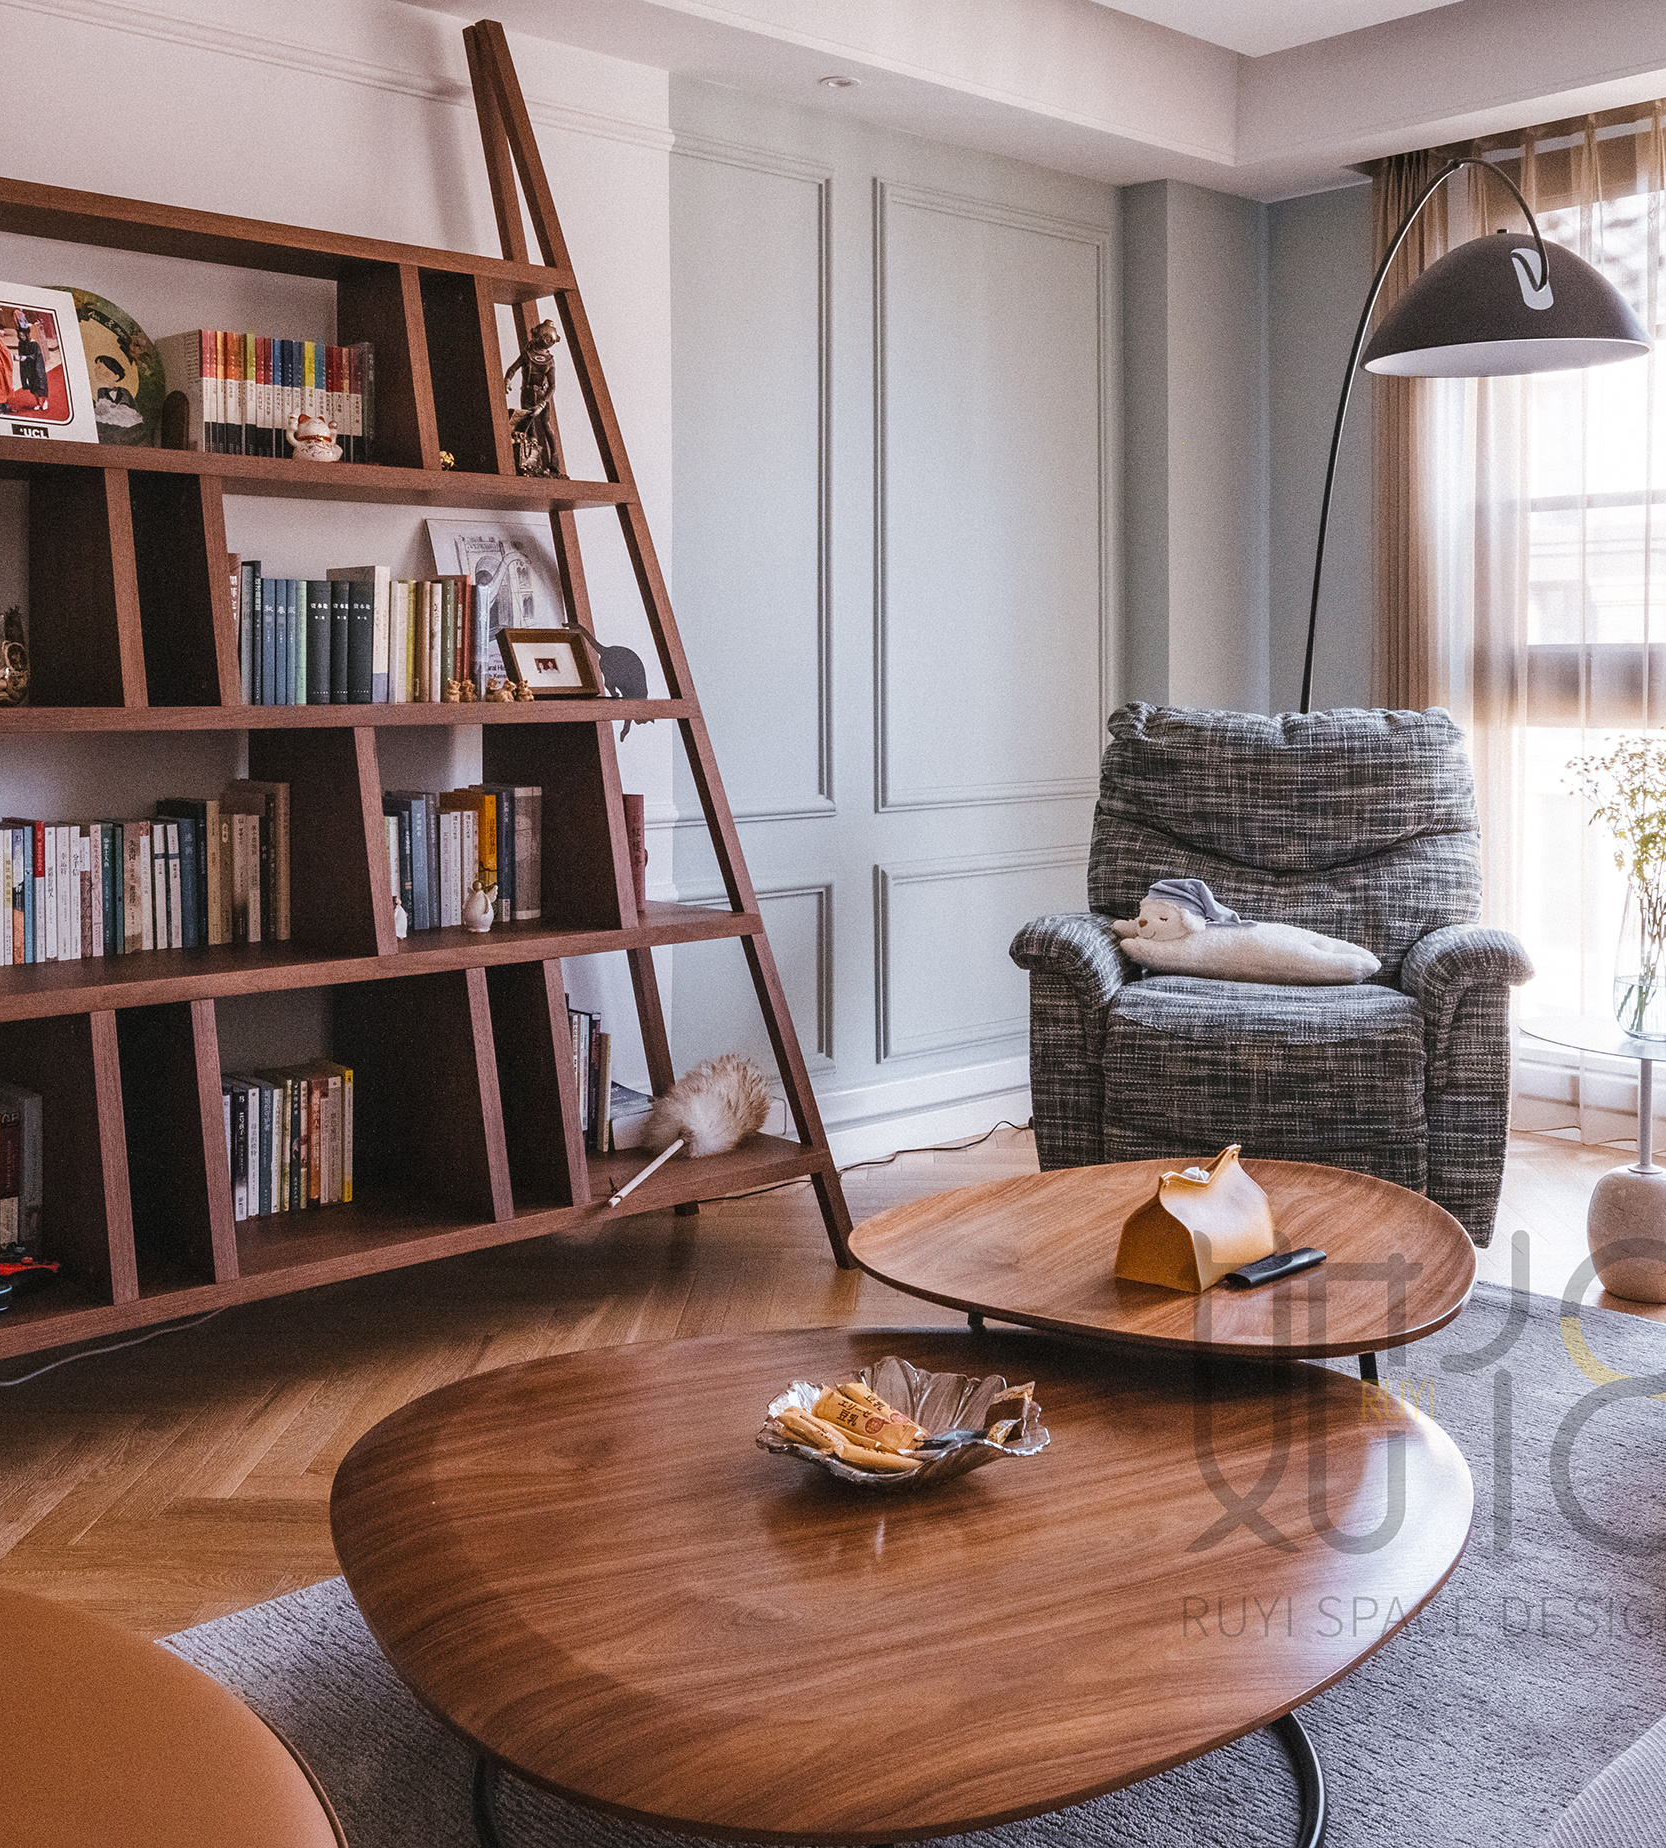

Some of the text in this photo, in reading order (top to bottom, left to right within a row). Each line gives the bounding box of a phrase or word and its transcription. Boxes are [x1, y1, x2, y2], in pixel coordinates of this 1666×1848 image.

[23, 427, 48, 438] UCL
[310, 602, 329, 610] 资本论
[353, 602, 372, 610] 资本论
